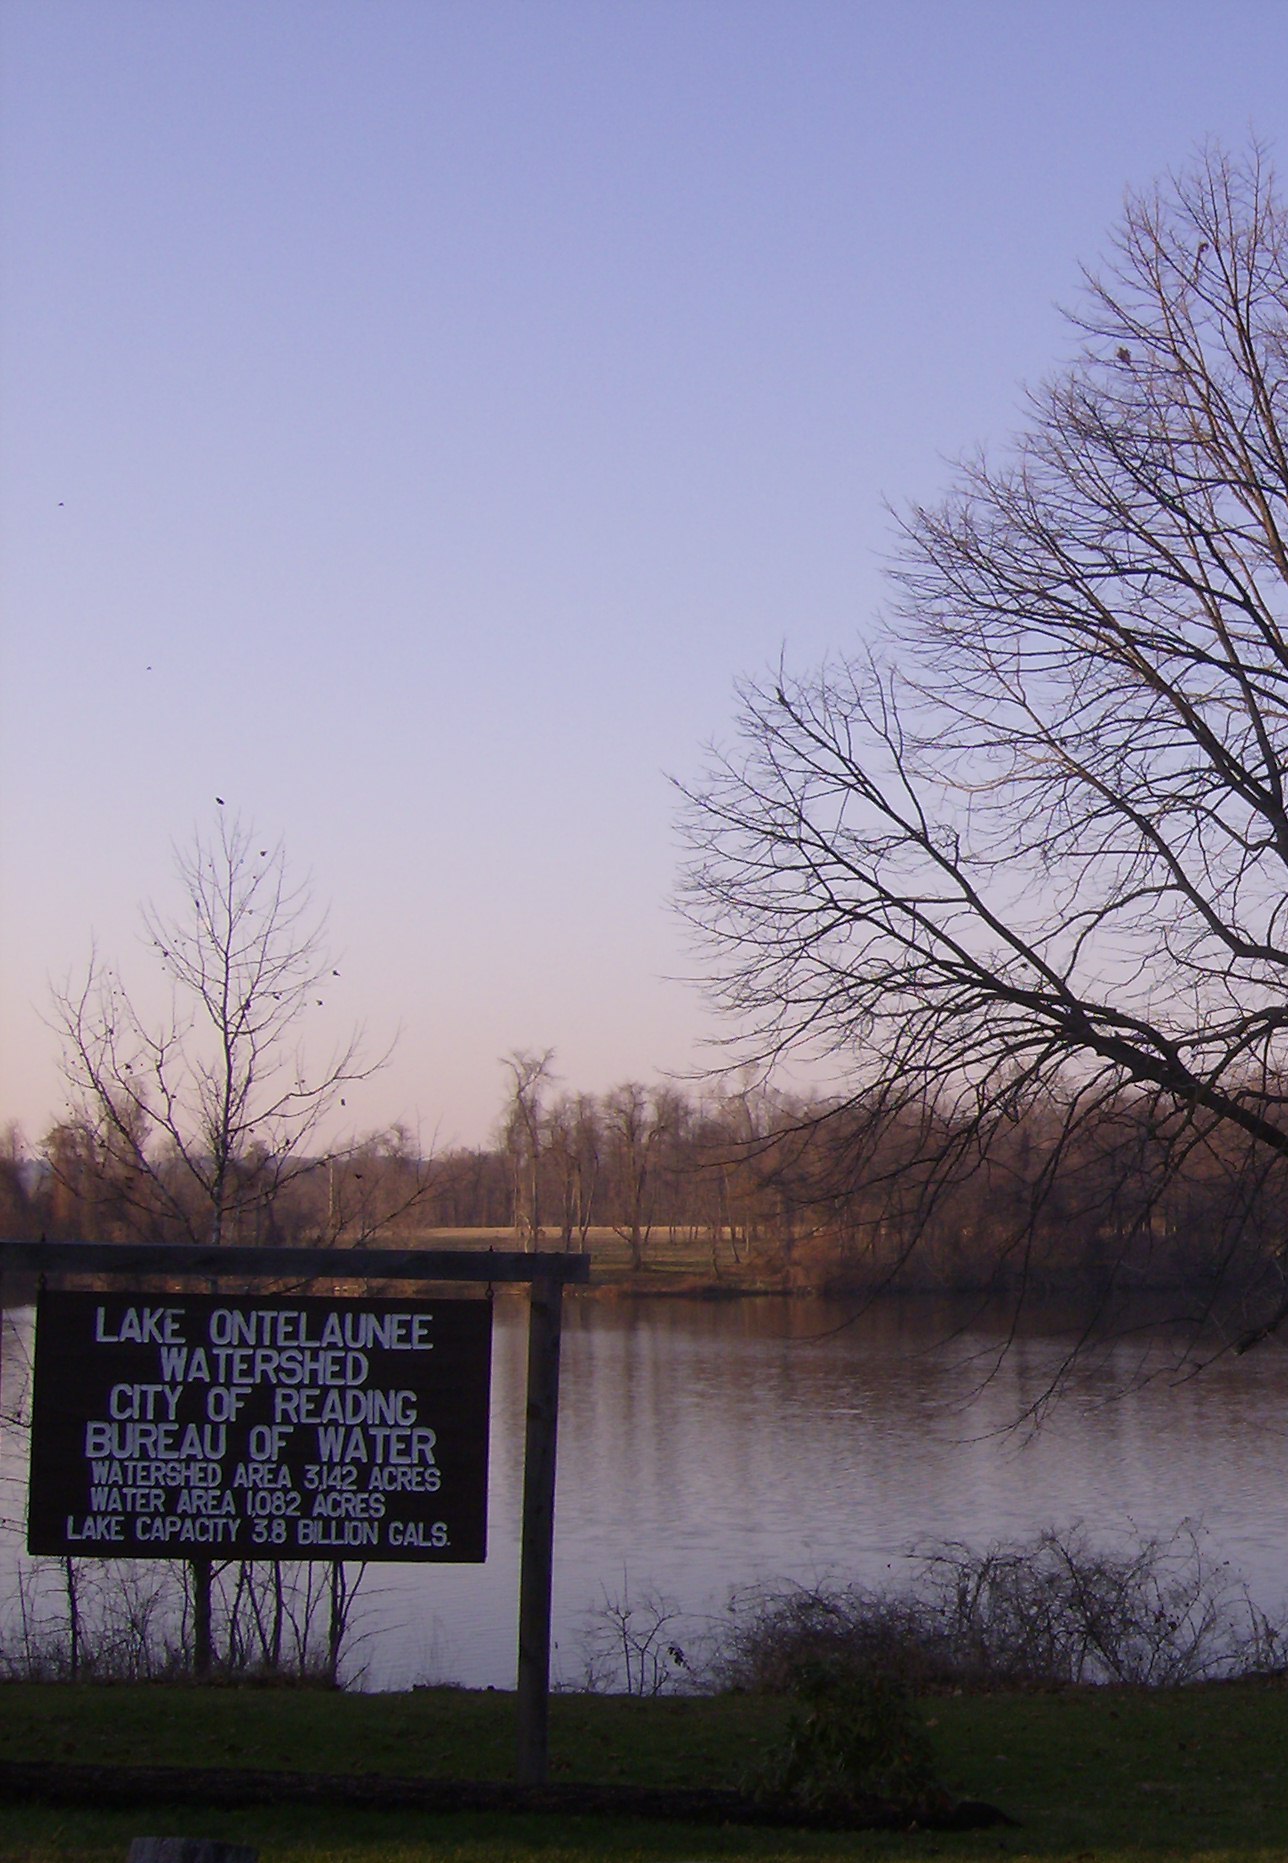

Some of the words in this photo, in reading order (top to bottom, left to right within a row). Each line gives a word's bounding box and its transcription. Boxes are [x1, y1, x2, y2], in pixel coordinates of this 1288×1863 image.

[96, 1306, 186, 1344] LAKE
[209, 1308, 433, 1350] ONTELAUNEE
[160, 1347, 369, 1386] WATERSHED
[110, 1384, 182, 1420] CITY
[207, 1386, 252, 1422] OF
[275, 1388, 418, 1426] READING
[85, 1421, 227, 1460] BUREAU
[249, 1425, 293, 1461] OF
[318, 1427, 436, 1465] WATER
[92, 1461, 222, 1488] WATERSHED
[233, 1463, 291, 1489] AREA
[369, 1466, 441, 1492] ACRES
[90, 1487, 165, 1513] WATER
[177, 1490, 236, 1515] AREA
[312, 1493, 386, 1518] ACRES
[66, 1515, 124, 1541] LAKE
[136, 1517, 242, 1543] CAPACITY
[298, 1520, 379, 1546] BILLION
[389, 1521, 451, 1548] GALS.
